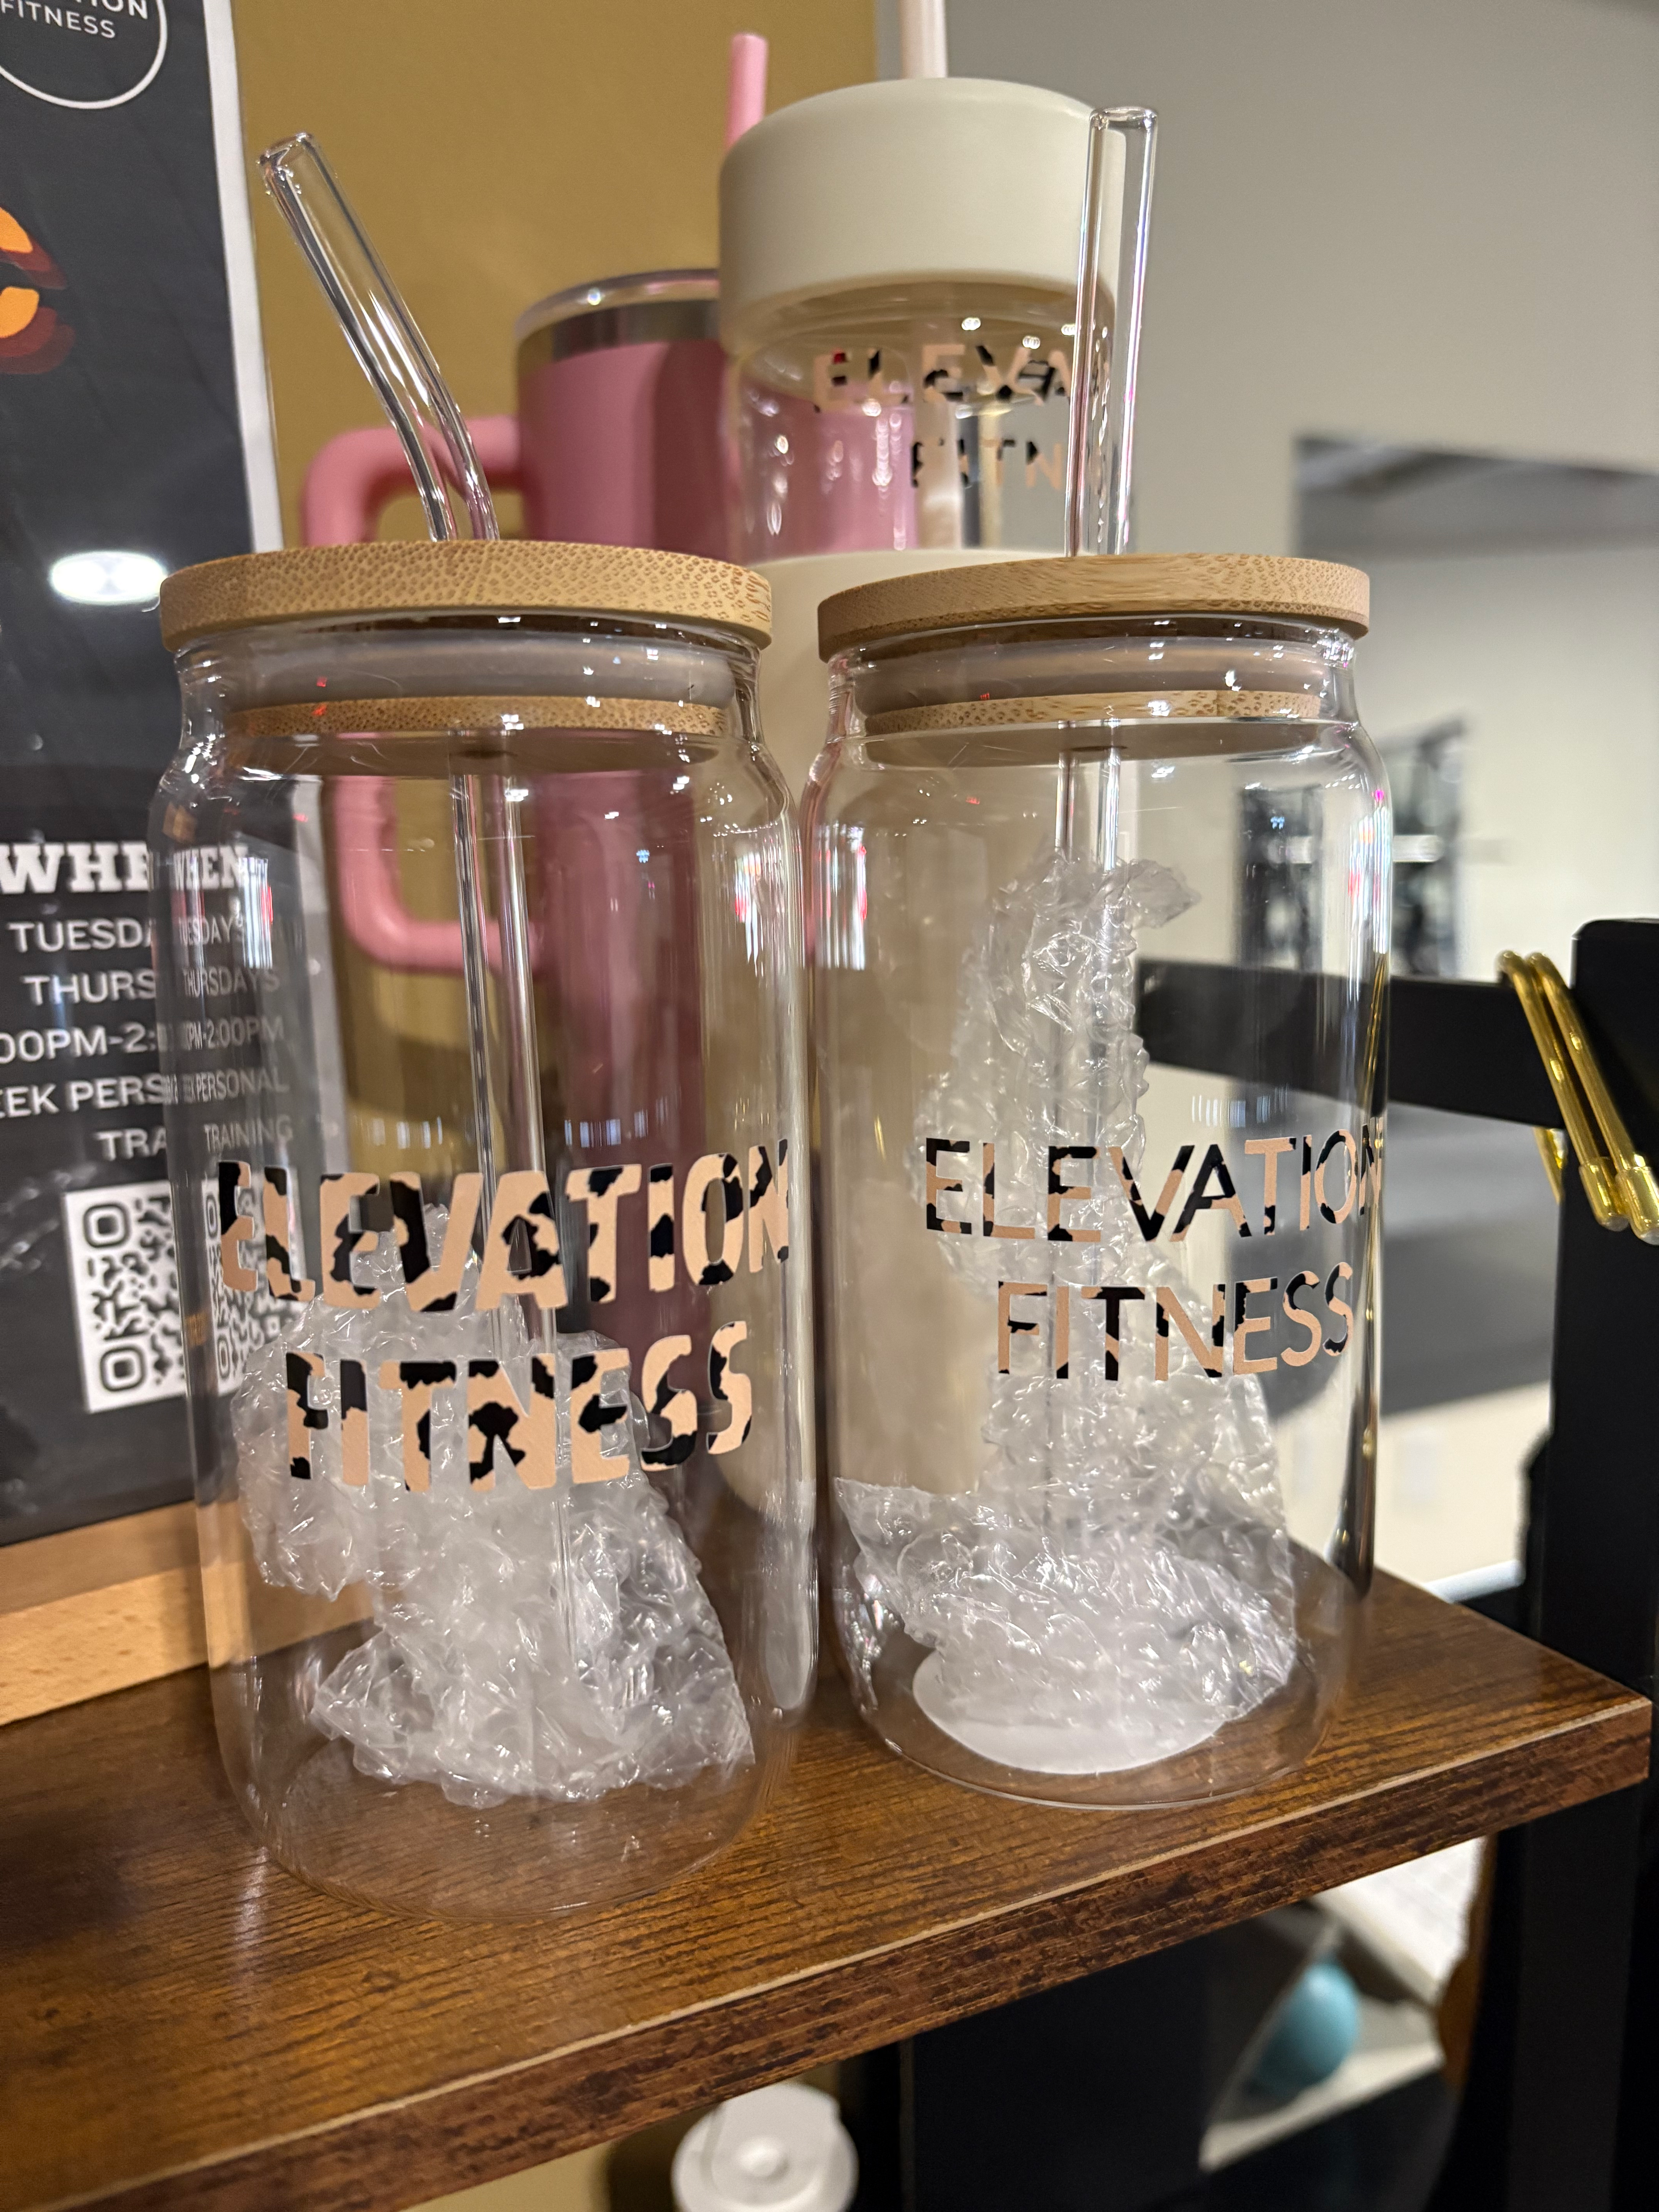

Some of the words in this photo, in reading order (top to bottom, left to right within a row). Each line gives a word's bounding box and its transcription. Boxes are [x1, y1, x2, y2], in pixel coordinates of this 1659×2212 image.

[0, 0, 115, 38] FITNESS
[812, 344, 1072, 413] ELEVA
[911, 438, 1063, 490] FITN
[8, 917, 152, 953] TUESD
[21, 968, 156, 1005] THURS
[926, 1117, 1382, 1242] ELEVATION
[218, 1138, 789, 1312] ELEVATION
[997, 1261, 1353, 1382] FITNESS
[286, 1320, 752, 1492] FITNESS
